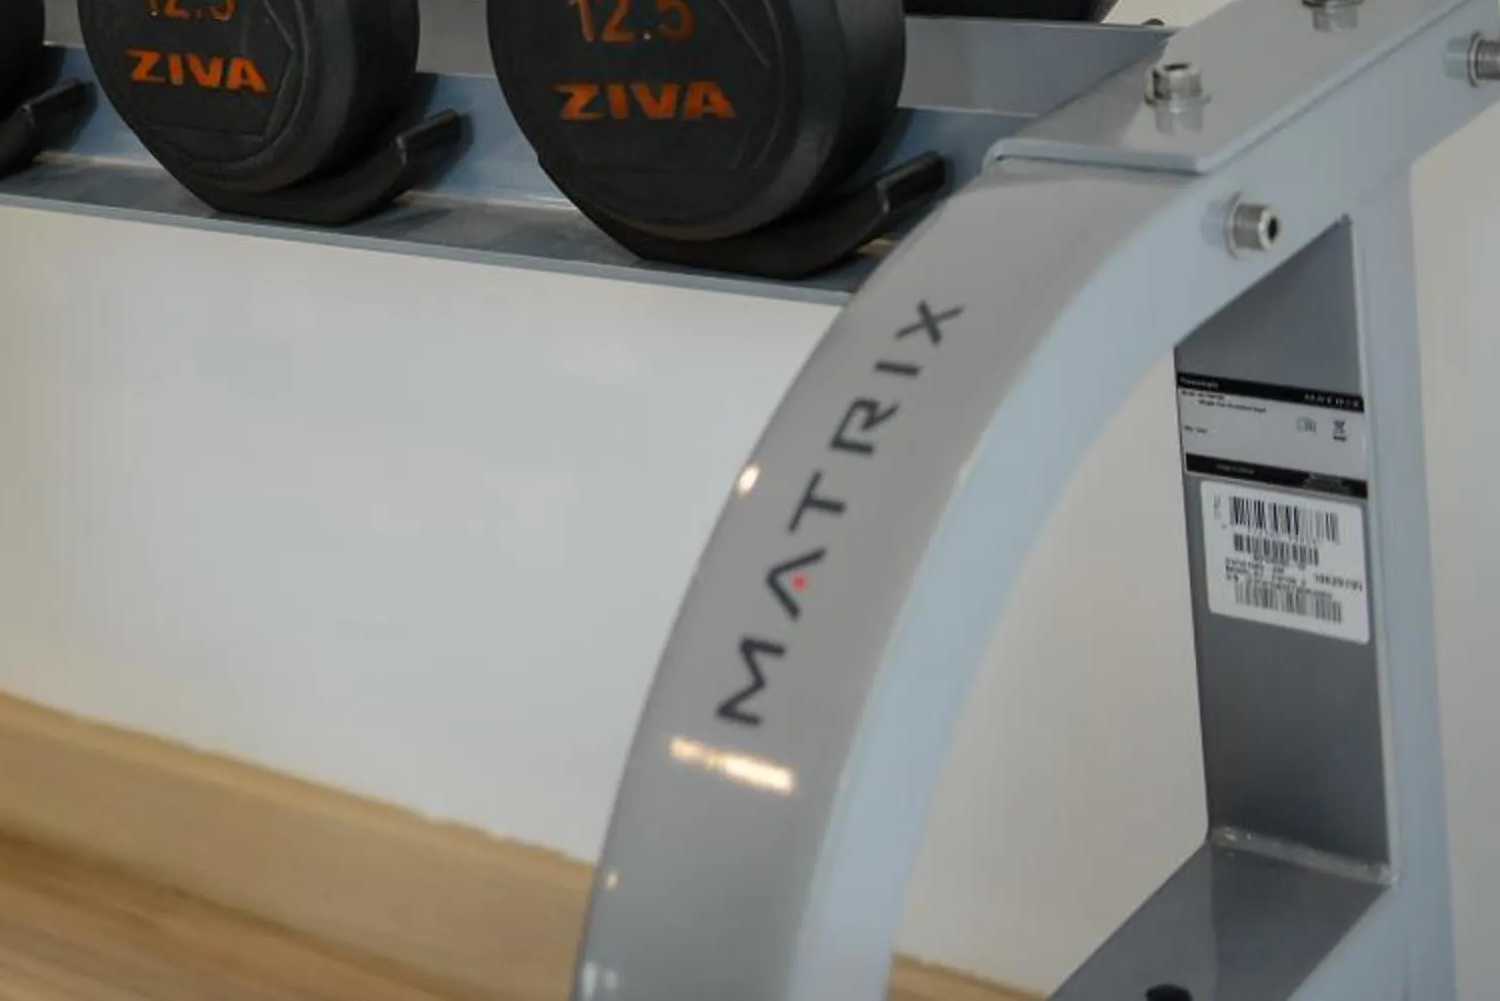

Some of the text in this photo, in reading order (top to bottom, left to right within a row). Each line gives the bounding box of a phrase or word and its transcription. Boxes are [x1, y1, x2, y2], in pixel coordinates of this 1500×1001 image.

[127, 49, 269, 94] ZIVA
[556, 80, 736, 120] ZIVA
[714, 299, 964, 727] MATRIX
